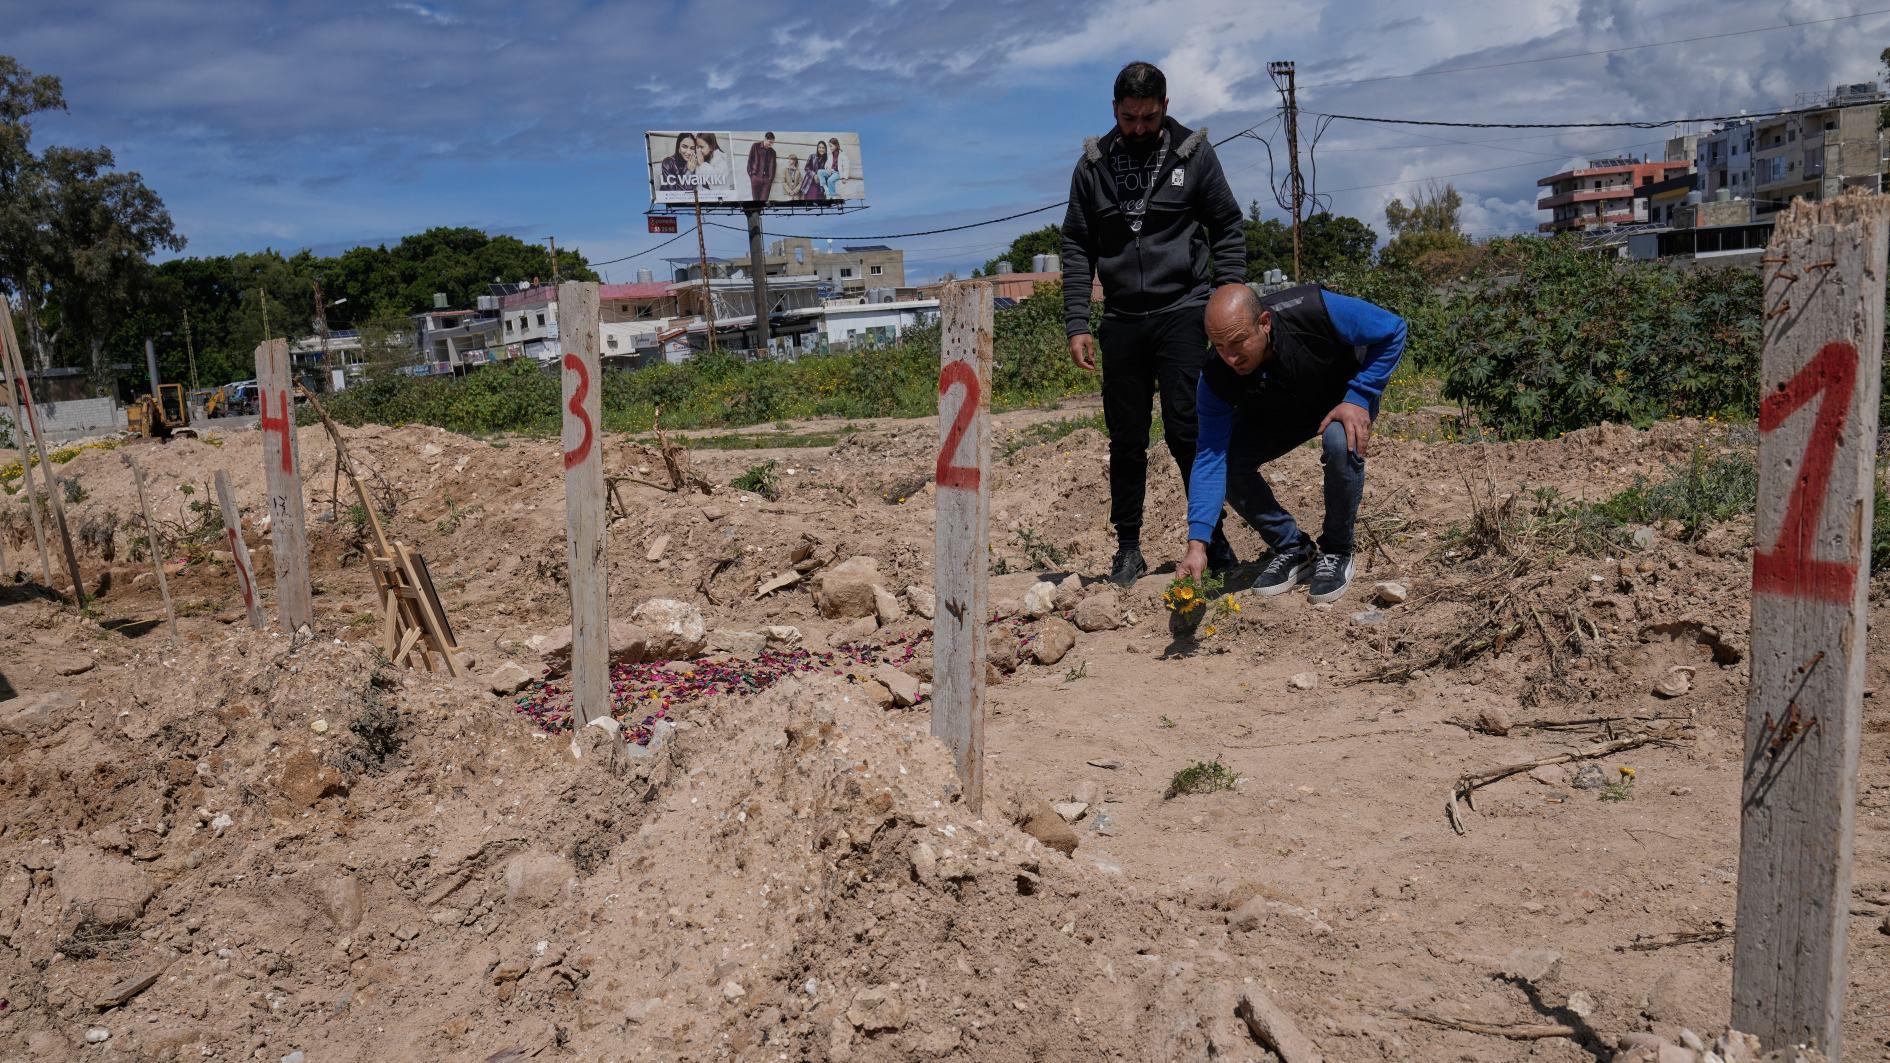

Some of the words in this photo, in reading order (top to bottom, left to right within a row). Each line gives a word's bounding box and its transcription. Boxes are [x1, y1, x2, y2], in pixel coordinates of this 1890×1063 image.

[660, 174, 677, 186] LC
[261, 386, 292, 476] 4
[564, 353, 593, 470] 3
[936, 360, 981, 491] 2
[1752, 340, 1860, 606] 1
